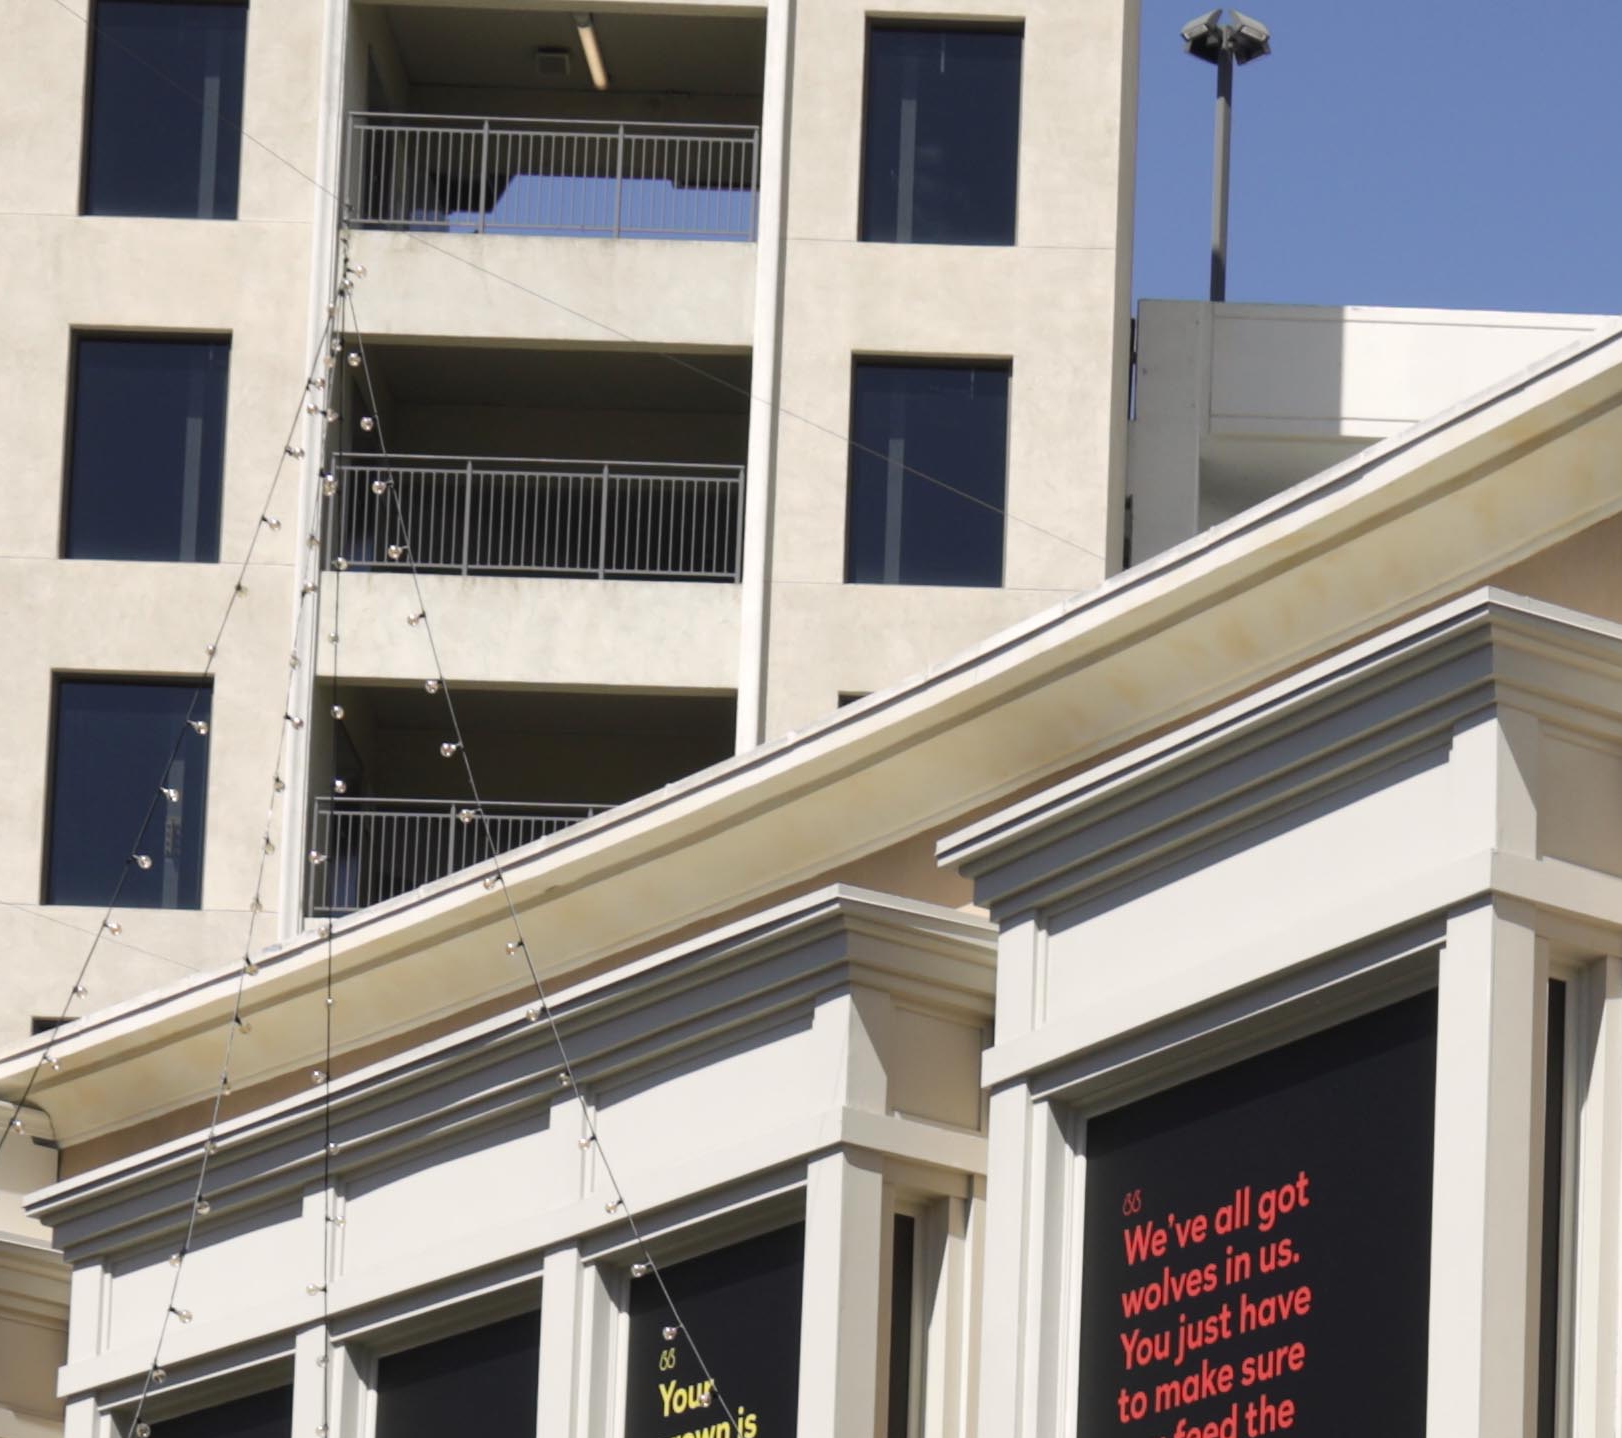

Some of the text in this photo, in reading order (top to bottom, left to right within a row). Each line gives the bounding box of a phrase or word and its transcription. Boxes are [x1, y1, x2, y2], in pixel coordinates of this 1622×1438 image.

[1124, 1171, 1309, 1266] We've all got
[1121, 1238, 1300, 1318] wolves in us.
[1120, 1285, 1311, 1370] You just have
[659, 1379, 714, 1418] Your
[1117, 1343, 1306, 1423] to make sure
[1245, 1396, 1294, 1436] the
